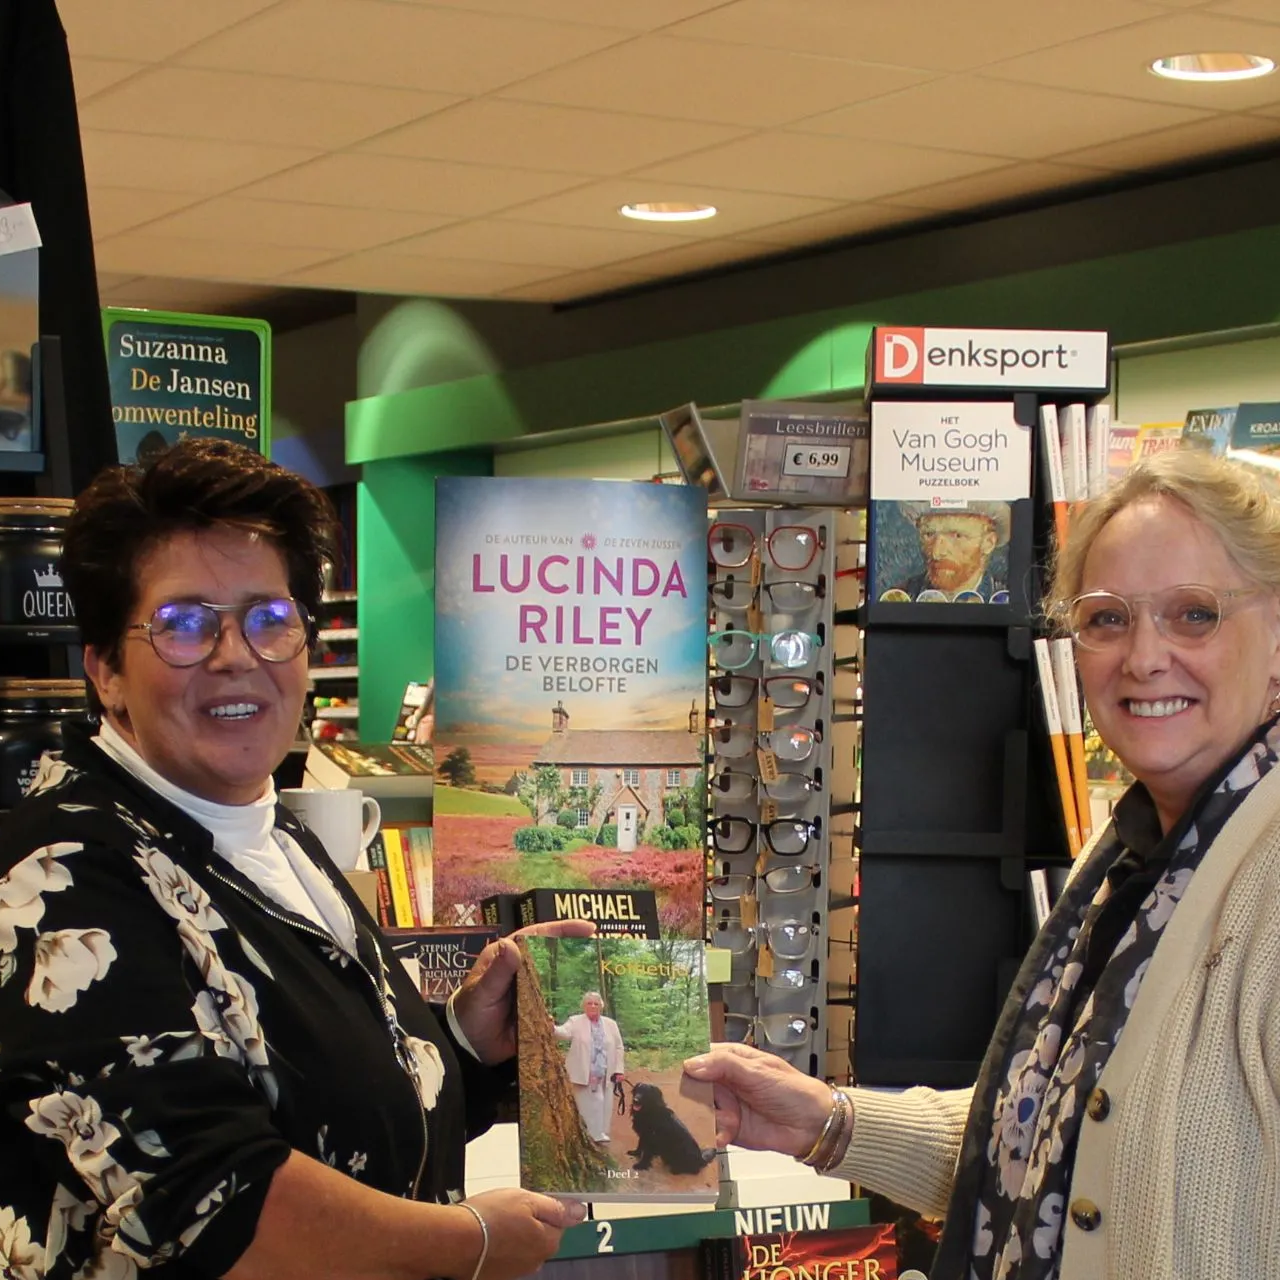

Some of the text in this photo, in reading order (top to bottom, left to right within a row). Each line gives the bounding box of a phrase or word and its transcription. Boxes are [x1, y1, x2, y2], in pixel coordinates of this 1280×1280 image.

[119, 334, 228, 365] Suzanna
[131, 368, 252, 400] De Jansen
[112, 404, 257, 439] omwenteling
[775, 419, 867, 437] Leesbrillen
[940, 416, 960, 425] HET
[892, 428, 1009, 454] Van Gogh
[793, 451, 840, 468] € 6,99
[900, 453, 1000, 473] Museum
[918, 477, 981, 488] PUZZELBOEK
[485, 534, 499, 545] DE
[550, 535, 574, 545] VAN
[472, 553, 688, 598] LUCINDA
[23, 590, 77, 618] QUEEN
[519, 604, 653, 646] RILEY
[505, 655, 659, 674] DE VERBORGEN
[542, 676, 628, 694] BELOFTE
[554, 893, 641, 921] MICHAEL
[420, 943, 460, 953] STEPHEN
[413, 952, 467, 969] KING
[425, 969, 468, 978] RICHARD
[606, 1168, 631, 1180] Deel
[751, 1243, 784, 1268] DE
